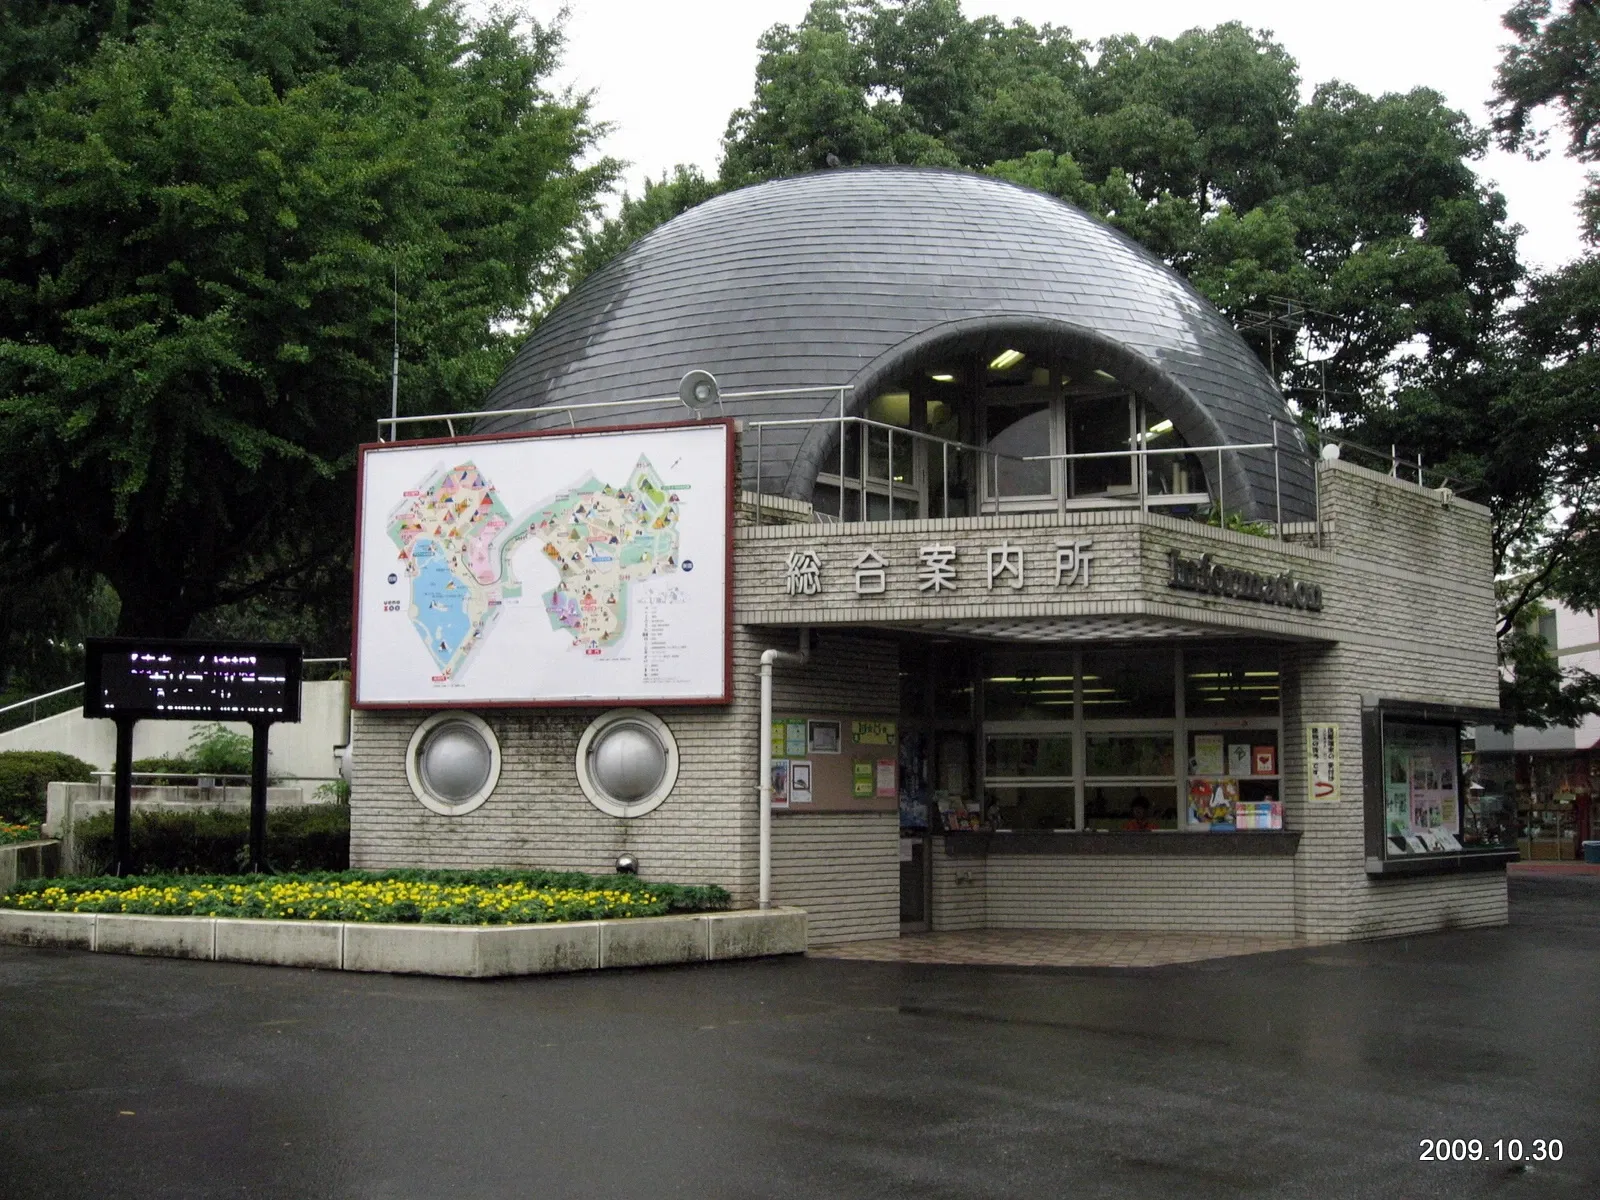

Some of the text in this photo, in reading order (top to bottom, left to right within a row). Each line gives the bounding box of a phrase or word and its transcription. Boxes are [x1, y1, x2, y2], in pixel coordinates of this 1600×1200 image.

[785, 539, 1093, 597] 総合案内所
[1167, 549, 1324, 612] Information
